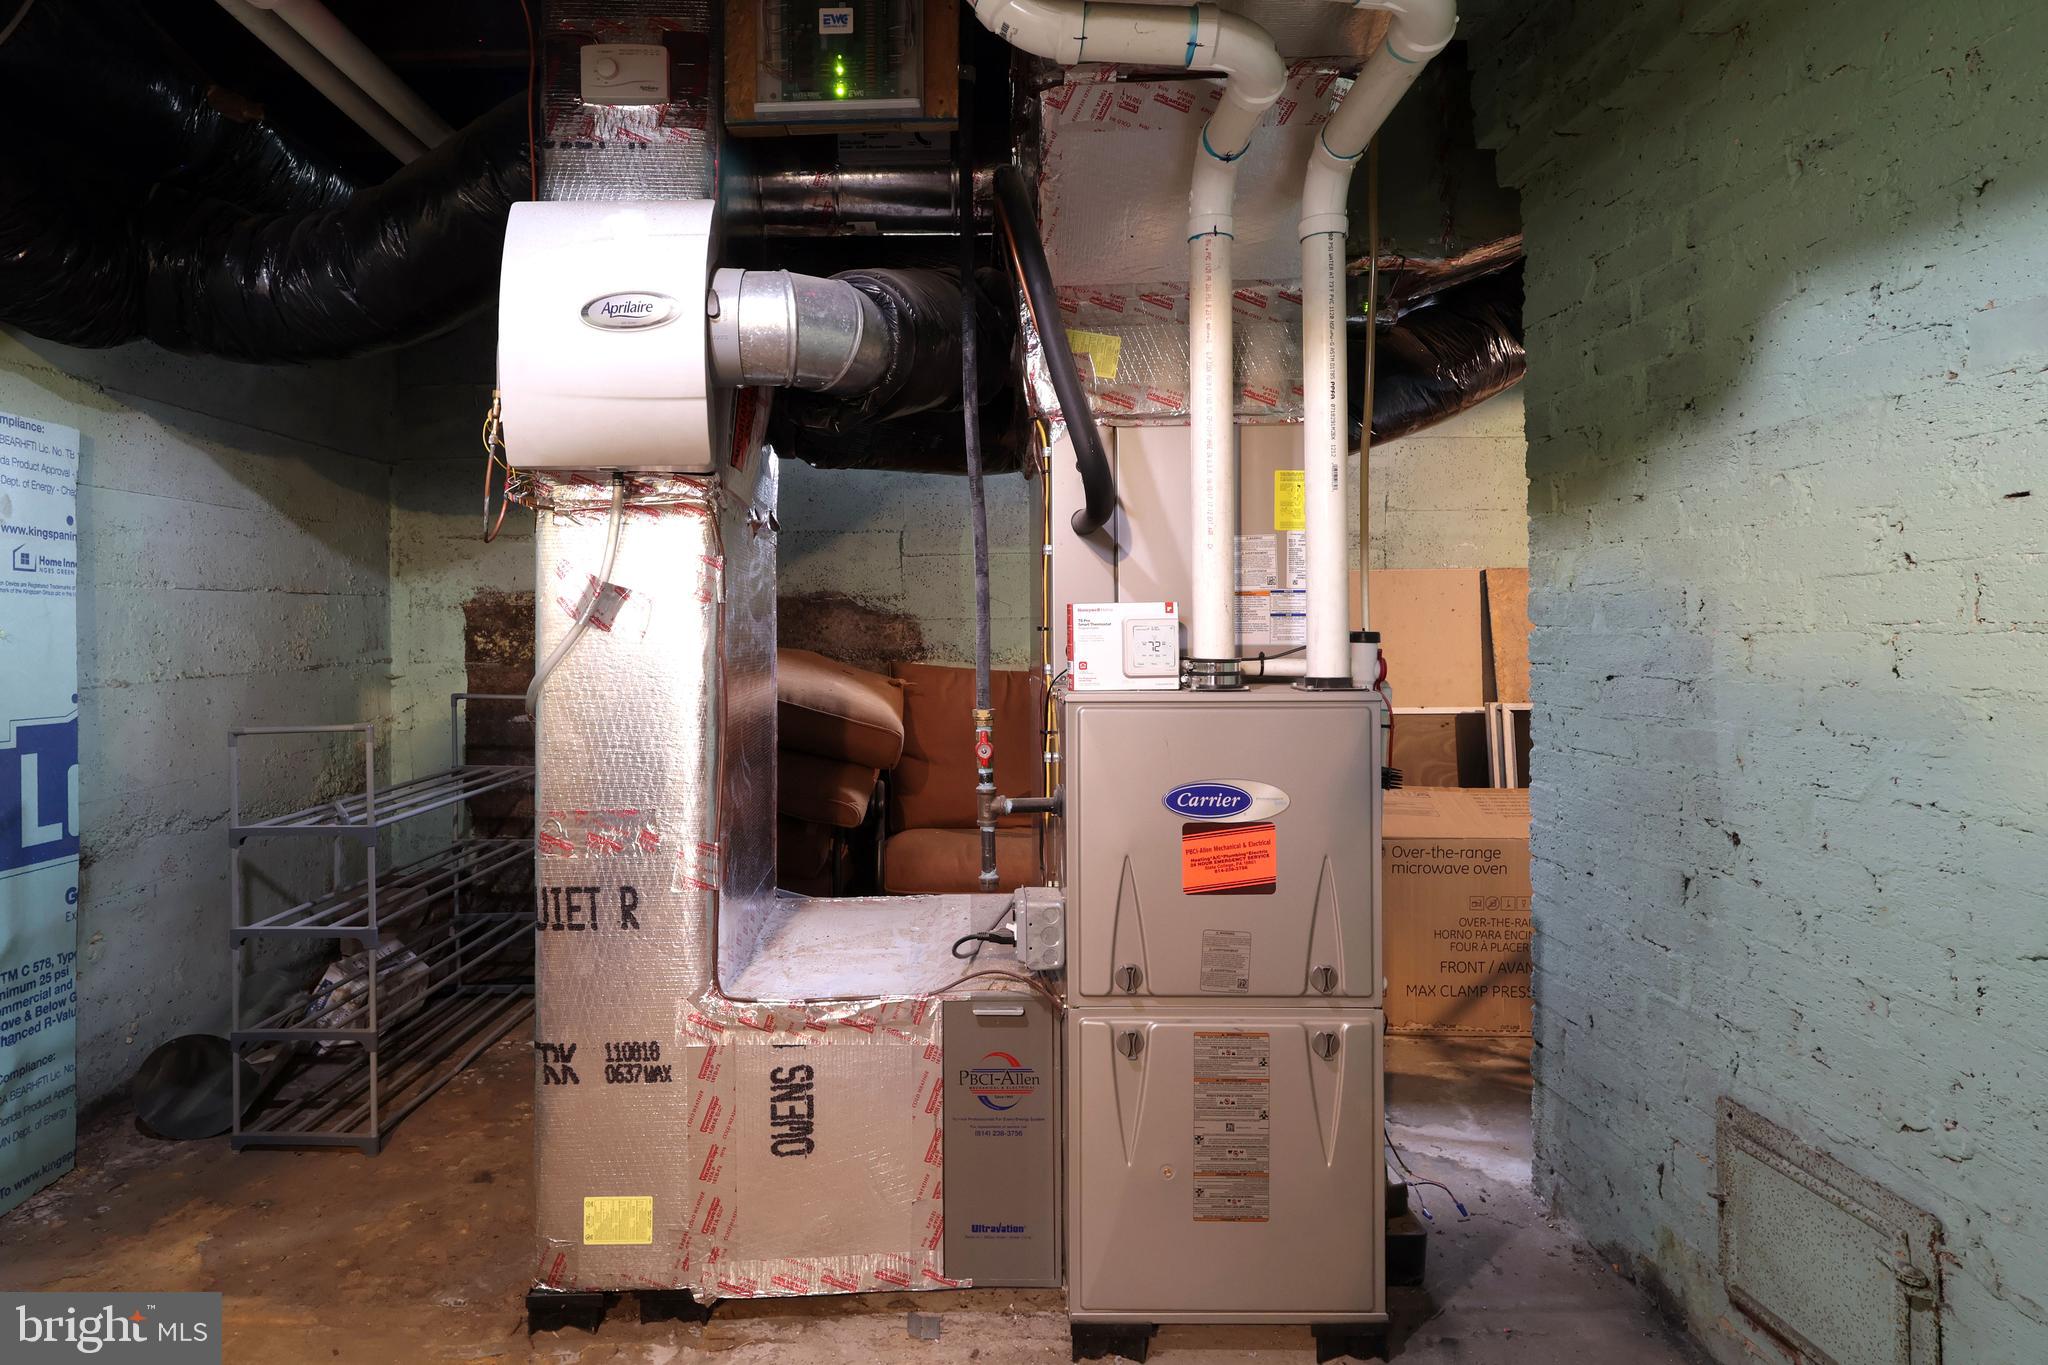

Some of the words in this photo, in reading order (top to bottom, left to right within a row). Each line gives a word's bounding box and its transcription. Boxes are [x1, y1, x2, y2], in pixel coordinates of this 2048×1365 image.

[601, 301, 653, 318] Aprilaire
[12, 457, 40, 472] Product
[41, 463, 71, 478] Approval
[0, 474, 20, 488] Dept.
[22, 480, 30, 489] of
[31, 480, 56, 496] Energy
[39, 555, 62, 567] Home
[1148, 641, 1161, 652] 72
[1177, 793, 1241, 808] Carrier
[1213, 842, 1241, 851] Mechanical
[1248, 839, 1272, 848] Electrical
[1391, 845, 1502, 861] Over-the-range
[1391, 863, 1470, 875] microwave
[1473, 865, 1508, 875] oven
[620, 886, 640, 930] R
[1434, 930, 1473, 940] HORNO
[1475, 930, 1502, 940] PARA
[1450, 942, 1479, 952] FOUR
[1491, 942, 1530, 953] PLACER
[21, 964, 30, 977] C
[33, 957, 55, 973] 578,
[1440, 961, 1486, 974] FRONT
[1489, 961, 1494, 974] /
[39, 973, 52, 987] 25
[54, 965, 70, 983] psi
[54, 978, 73, 995] and
[1406, 985, 1436, 997] MAX
[1440, 985, 1488, 997] CLAMP
[24, 1010, 33, 1022] &
[35, 996, 67, 1018] Below
[960, 1069, 1040, 1087] PBCI-Allen
[23, 1093, 52, 1115] Product
[769, 1064, 815, 1158] OWENS
[34, 1119, 42, 1131] of
[43, 1107, 69, 1126] Energy
[971, 1222, 1025, 1234] Ultravation
